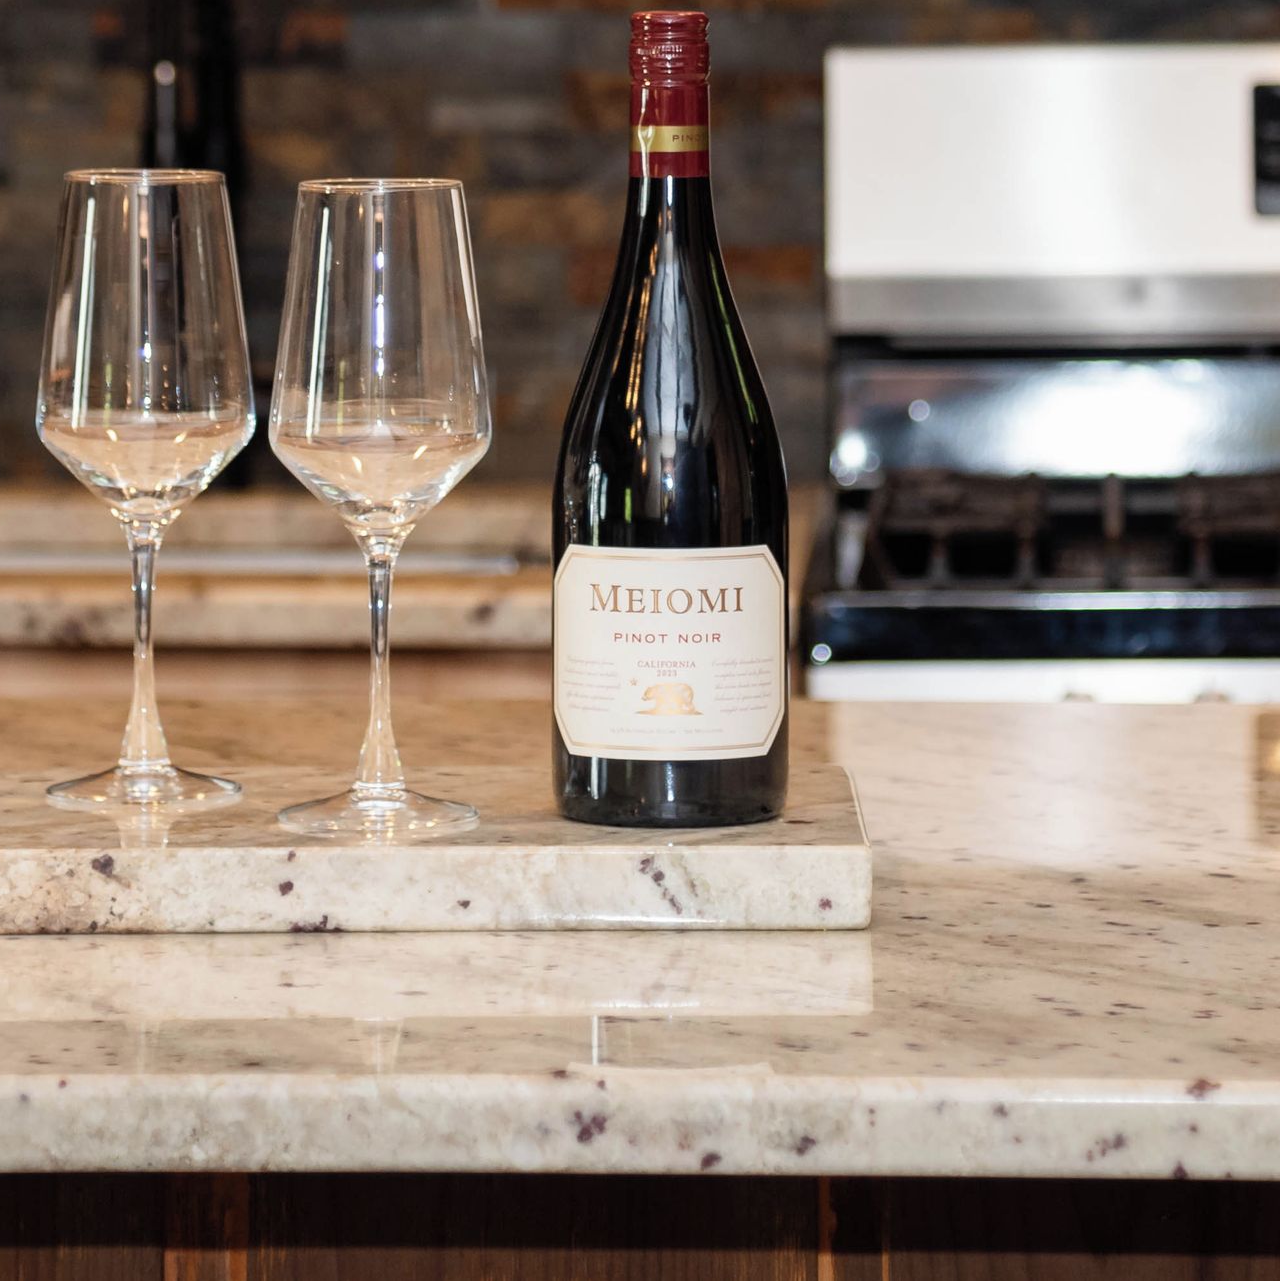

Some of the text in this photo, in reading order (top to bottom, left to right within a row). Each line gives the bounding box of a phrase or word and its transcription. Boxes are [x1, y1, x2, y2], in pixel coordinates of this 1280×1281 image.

[589, 583, 744, 614] MEIOMI
[614, 632, 722, 644] PINOT NOIR
[637, 660, 697, 669] CALIFORNIA
